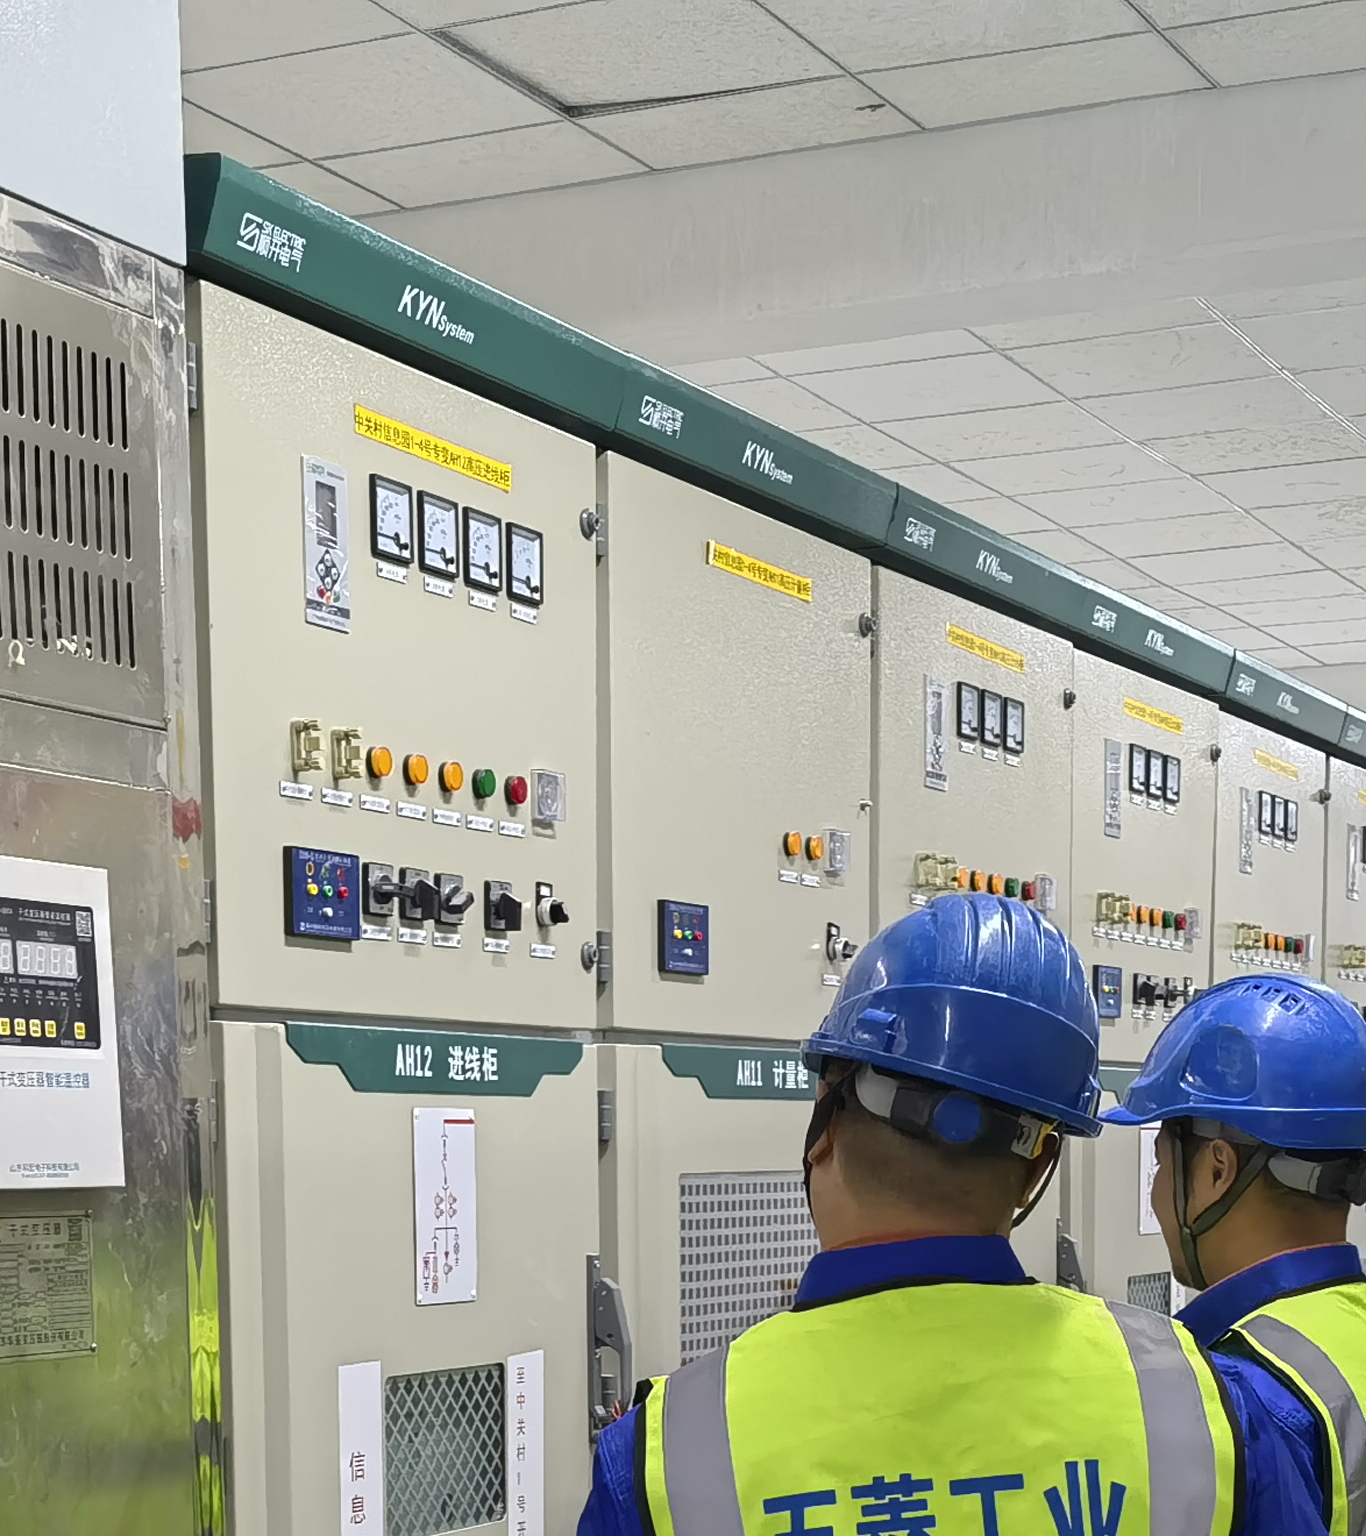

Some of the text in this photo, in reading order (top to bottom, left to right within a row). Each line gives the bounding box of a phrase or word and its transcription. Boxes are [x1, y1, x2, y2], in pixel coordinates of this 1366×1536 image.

[395, 1044, 498, 1081] AH12 进线柜
[736, 1060, 763, 1087] AH11
